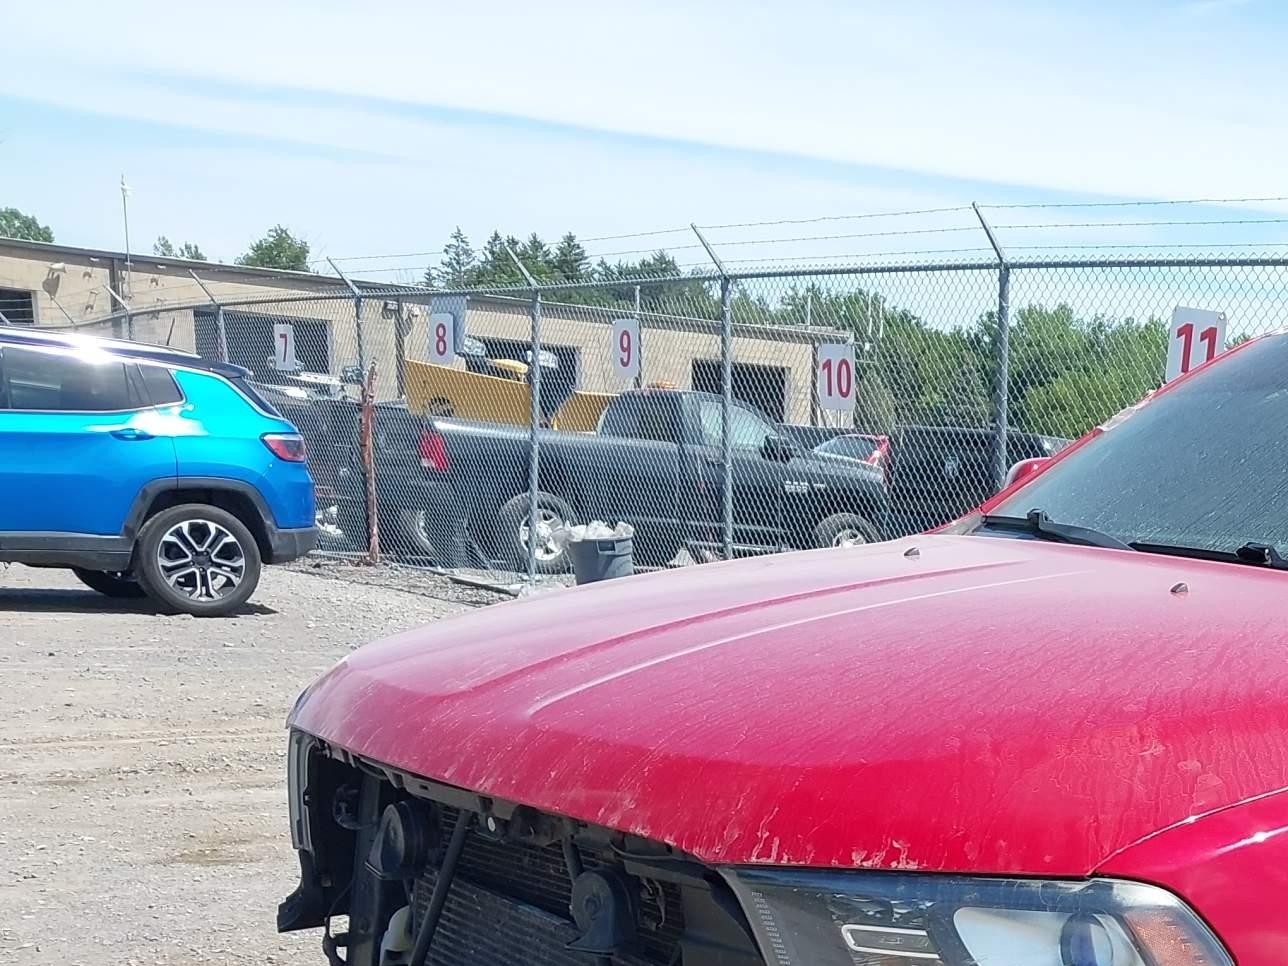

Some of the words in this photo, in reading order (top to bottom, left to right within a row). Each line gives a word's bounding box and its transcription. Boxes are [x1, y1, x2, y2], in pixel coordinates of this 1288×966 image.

[278, 333, 290, 363] 7
[434, 322, 449, 356] 8
[618, 330, 633, 368] 9
[1175, 322, 1219, 373] 11
[822, 358, 853, 399] 10
